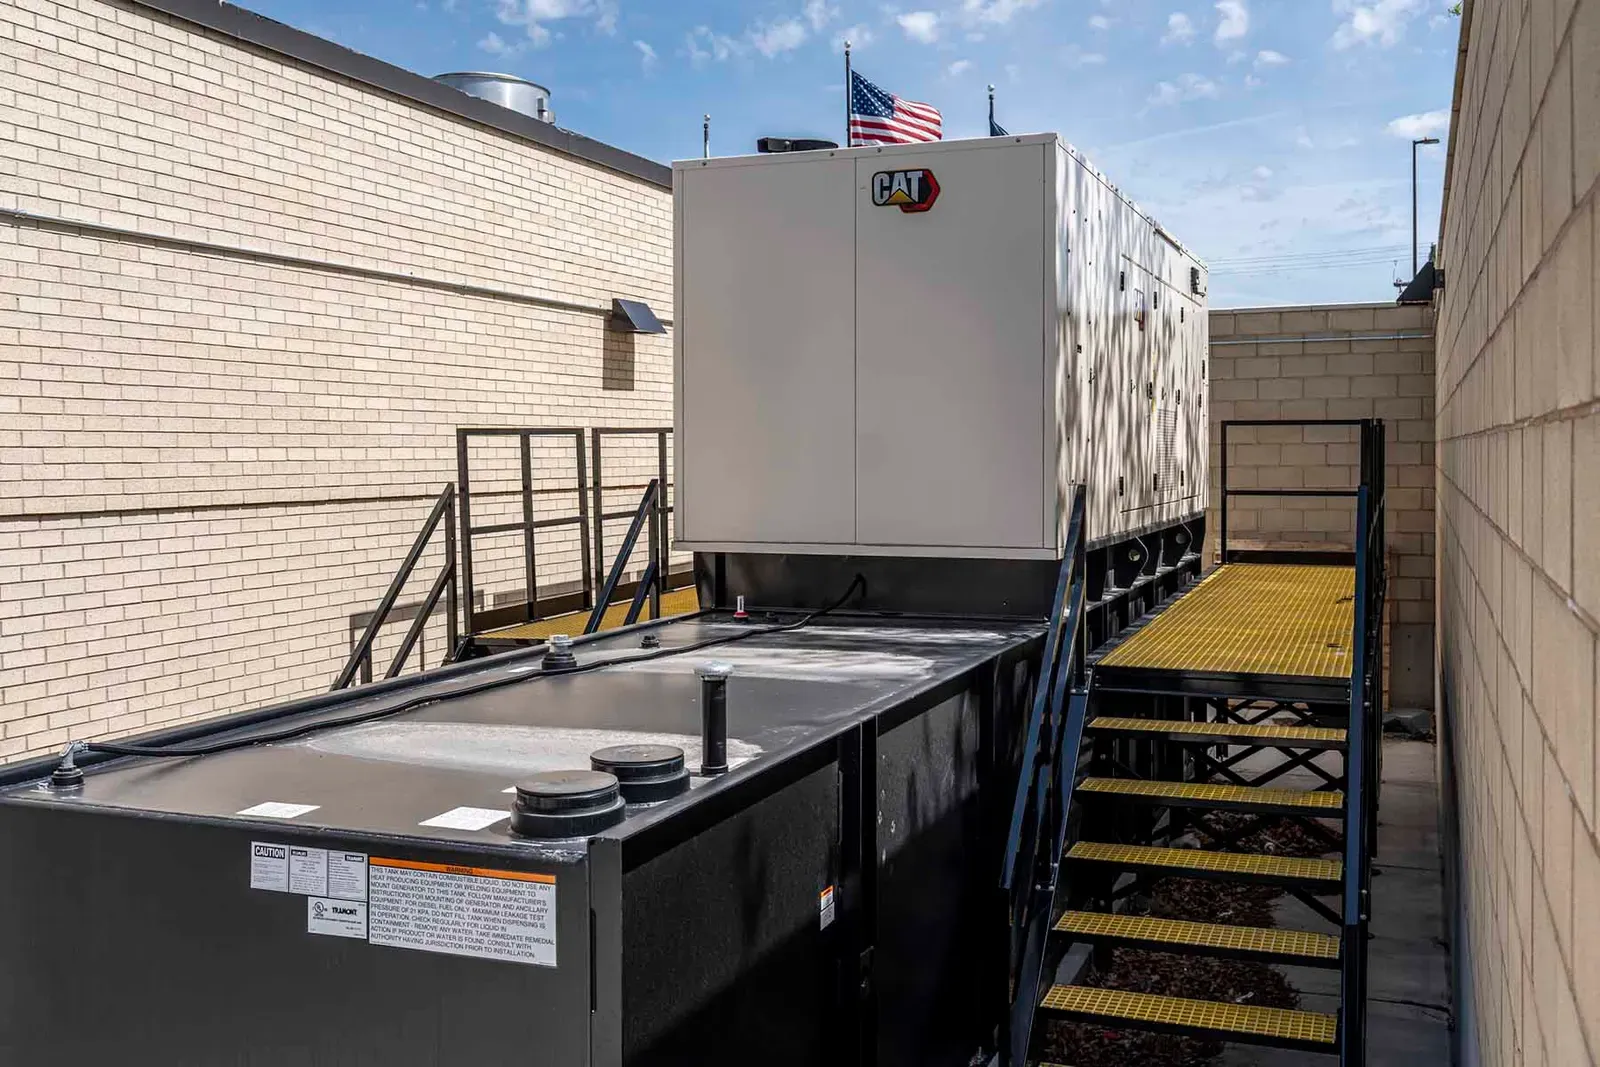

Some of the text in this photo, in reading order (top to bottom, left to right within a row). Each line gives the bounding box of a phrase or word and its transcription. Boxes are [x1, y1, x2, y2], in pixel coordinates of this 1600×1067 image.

[874, 170, 922, 204] CAT
[256, 846, 284, 858] CAUTION
[386, 876, 419, 885] PRODUCING
[420, 880, 452, 888] EQUIPMENT
[464, 884, 491, 892] WELDING
[492, 887, 526, 896] EQUIPMENT
[438, 874, 478, 883] COMBUSTIBLE
[391, 884, 426, 893] GENERATOR
[468, 892, 492, 900] FOLLOW
[371, 889, 411, 899] INSTRUCTIONS
[425, 895, 455, 904] MOUNTING
[465, 899, 501, 909] GENERATOR
[515, 905, 548, 914] ANCILLARY
[332, 907, 358, 916] TRAMONT
[371, 903, 400, 912] PRESSURE
[502, 918, 538, 928] DISPENSING
[472, 908, 500, 916] MAXIMUM
[501, 911, 528, 919] LEAKAGE
[432, 918, 467, 927] REGULARLY
[371, 918, 409, 928] CONTAINMENT
[414, 923, 438, 931] REMOVE
[492, 932, 524, 942] IMMEDIATE
[525, 936, 555, 946] REMEDIAL
[398, 929, 425, 937] PRODUCT
[488, 939, 515, 948] CONSULT
[371, 933, 401, 942] AUTHORITY
[403, 936, 424, 944] HAVING
[425, 939, 464, 950] JURISDICTION
